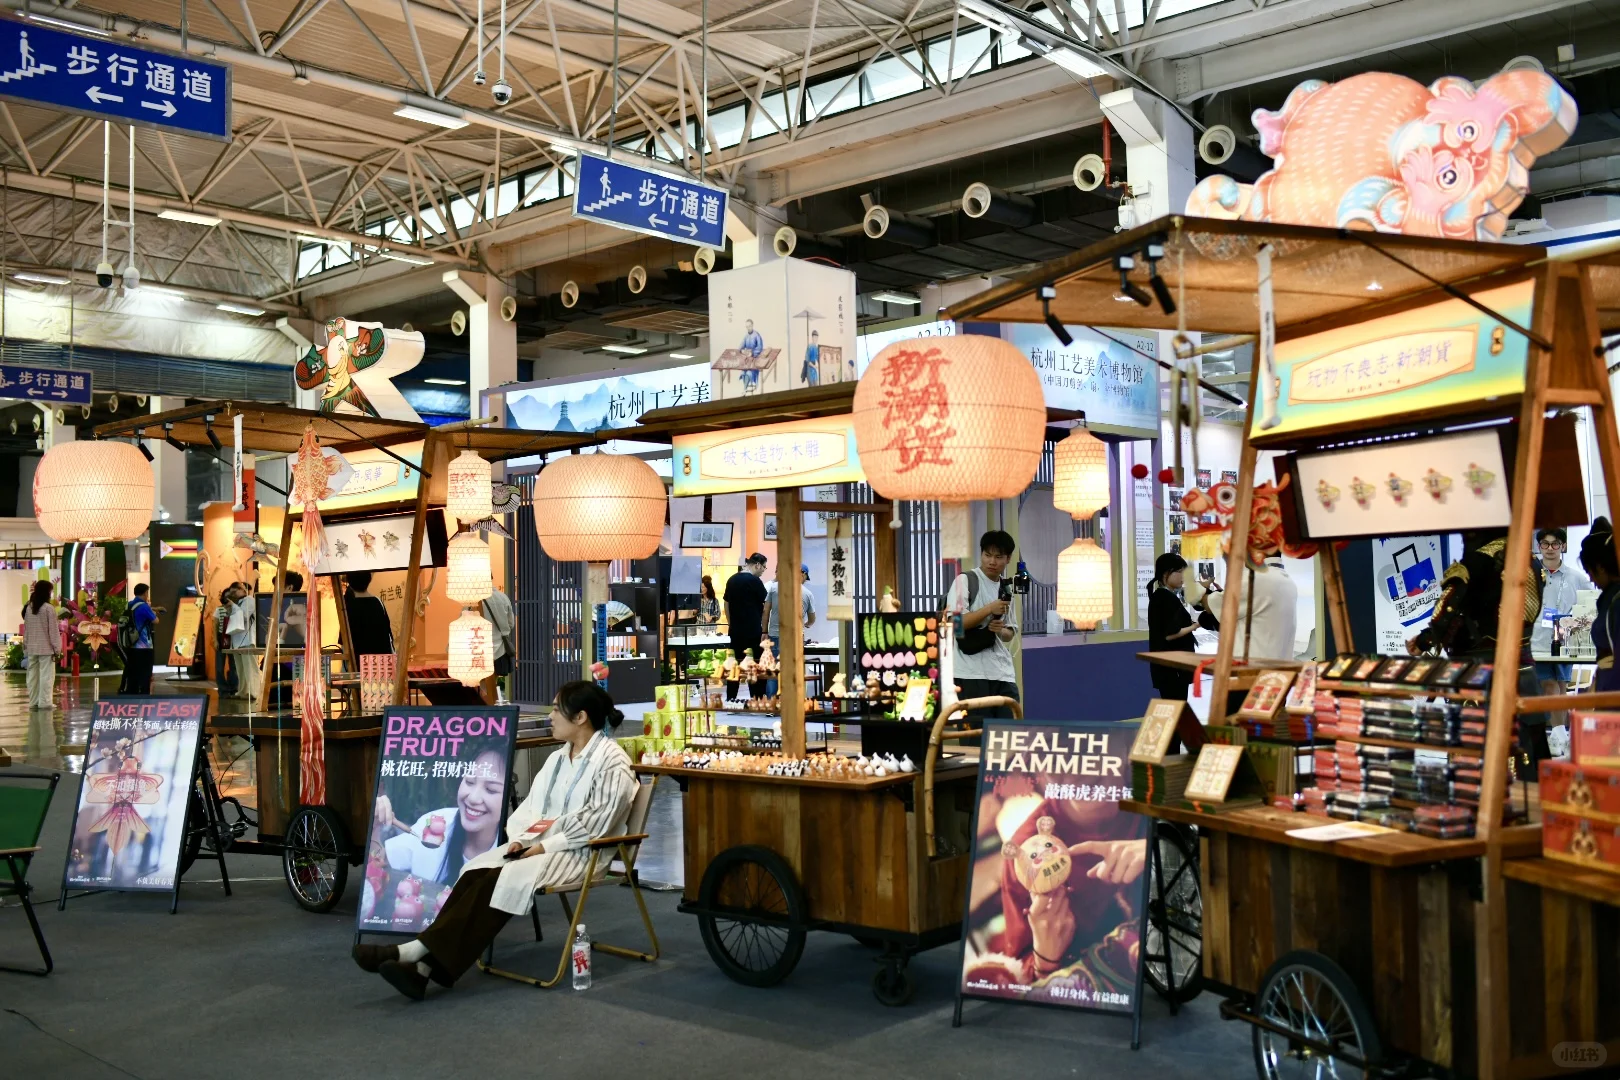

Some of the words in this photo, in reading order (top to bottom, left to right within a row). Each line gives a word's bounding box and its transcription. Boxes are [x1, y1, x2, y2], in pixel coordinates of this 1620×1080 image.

[67, 45, 212, 103] 步行通道
[638, 178, 720, 225] 步行通道
[1030, 346, 1143, 385] 杭州工艺美术博物馆
[19, 371, 84, 390] 步行通道
[831, 546, 846, 597] 造物集
[97, 701, 139, 717] TAKE
[140, 704, 155, 717] IT
[156, 701, 202, 717] EASY
[386, 716, 507, 736] DRAGON
[383, 737, 465, 757] FRUIT
[988, 730, 1109, 755] HEALTH
[985, 751, 1123, 777] HAMMER
